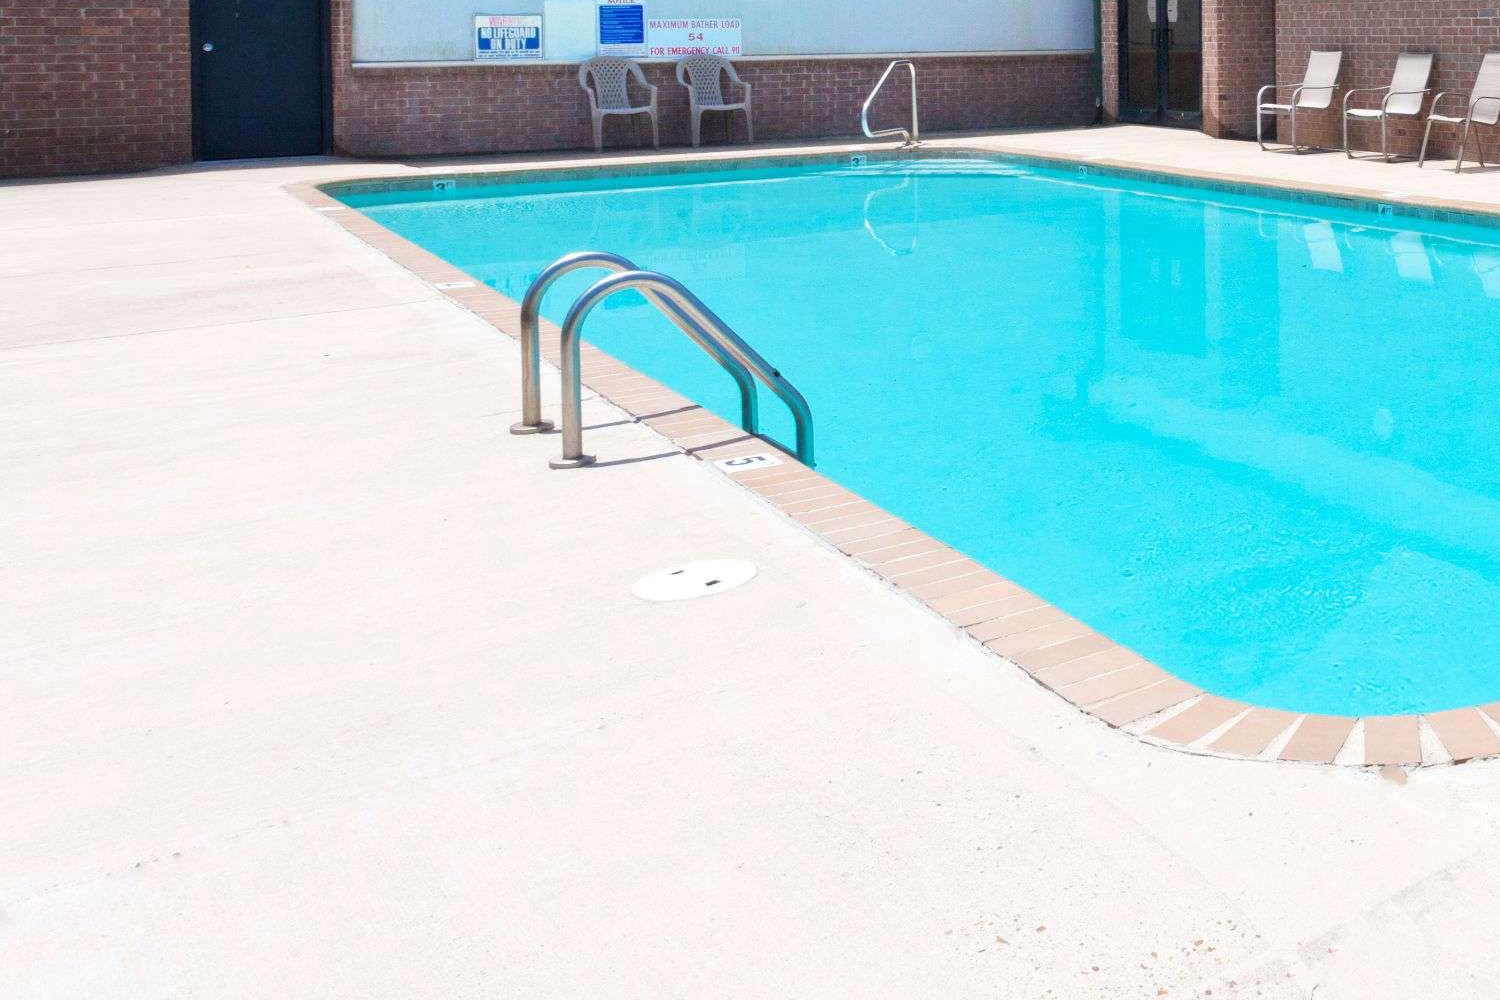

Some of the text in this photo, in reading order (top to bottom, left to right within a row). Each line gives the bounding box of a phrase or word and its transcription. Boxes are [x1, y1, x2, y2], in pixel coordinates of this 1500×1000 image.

[650, 20, 740, 29] MAXIMUM BATHER LOAD
[494, 27, 536, 39] LIFEGUARD
[688, 33, 704, 41] 54
[490, 38, 527, 50] ON DUTY
[650, 47, 666, 56] FOR
[668, 46, 709, 56] EMERGENCY
[712, 46, 729, 55] CALL
[725, 456, 766, 466] 5
